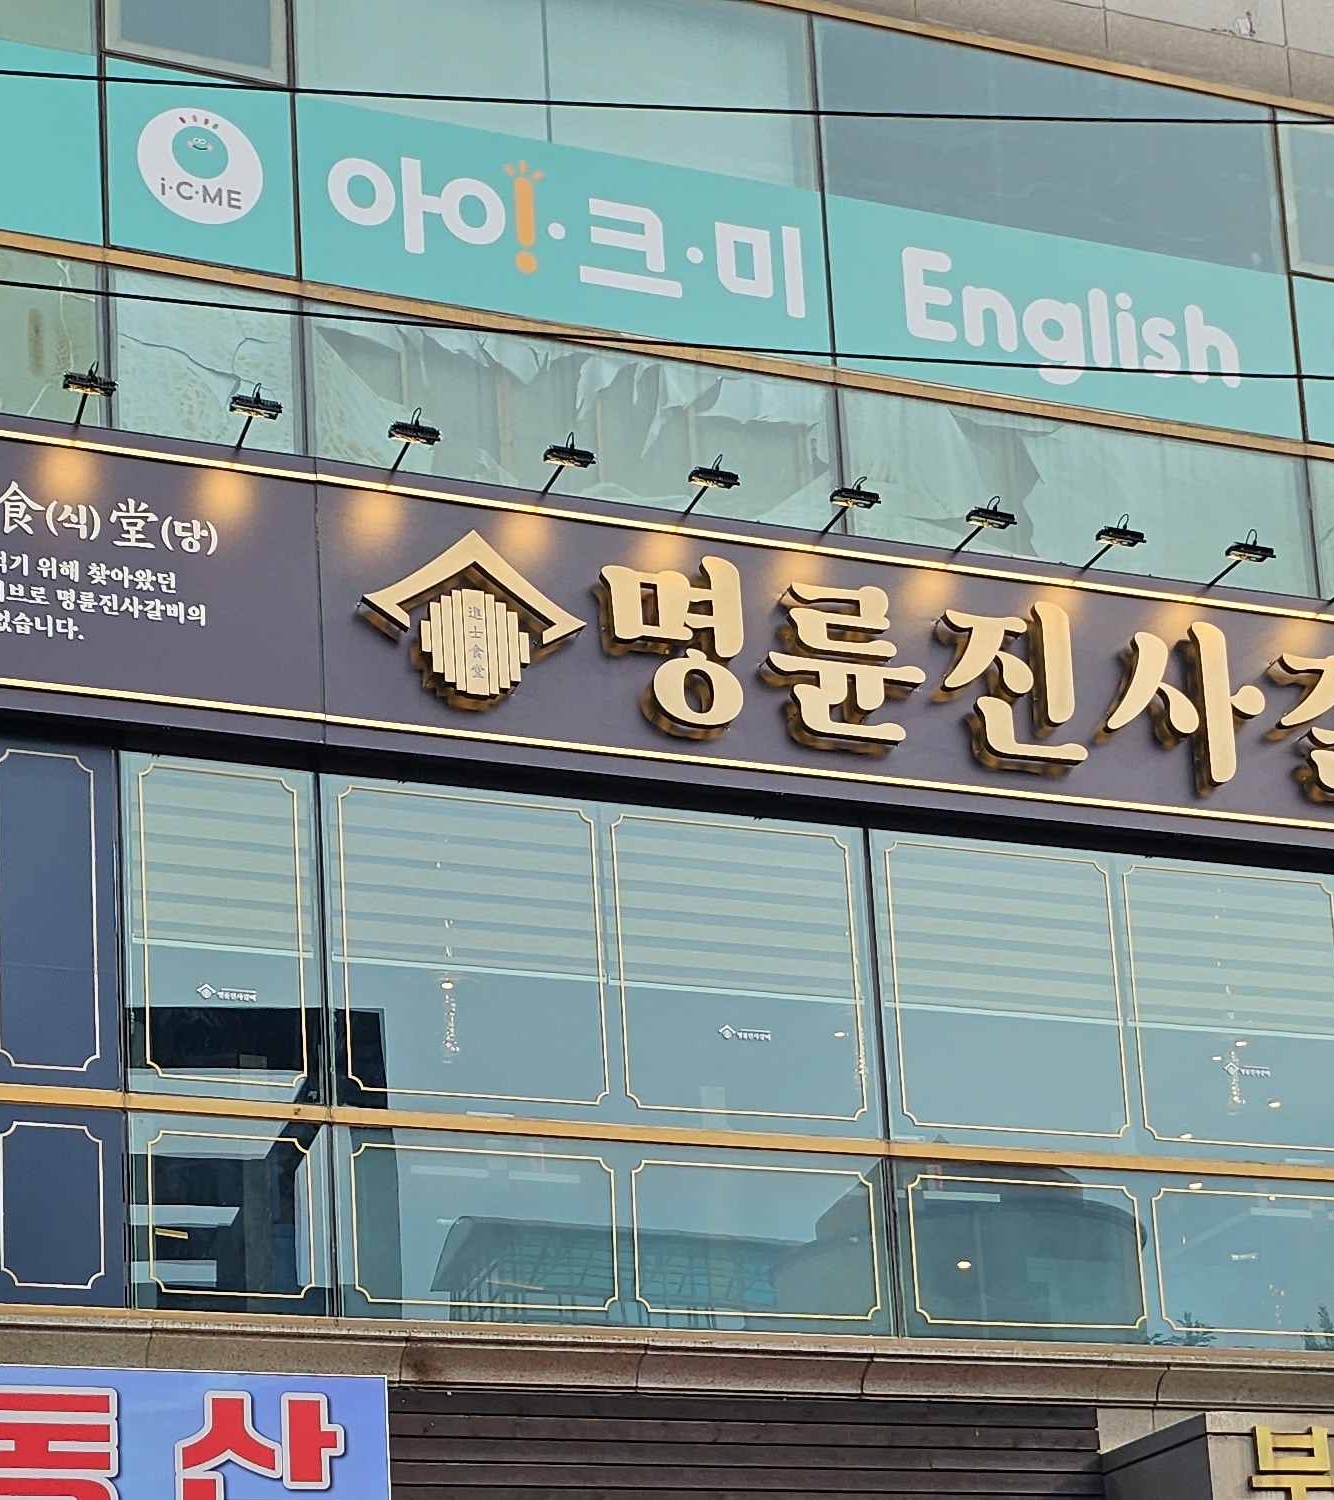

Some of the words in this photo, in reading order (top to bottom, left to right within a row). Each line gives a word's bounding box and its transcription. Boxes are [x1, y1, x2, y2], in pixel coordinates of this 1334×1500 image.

[901, 246, 1241, 388] English
[36, 555, 80, 584] 위해
[86, 562, 178, 595] 찾아왔던
[55, 585, 208, 627] 명륜진사갈비의
[468, 605, 486, 680] 進士食堂
